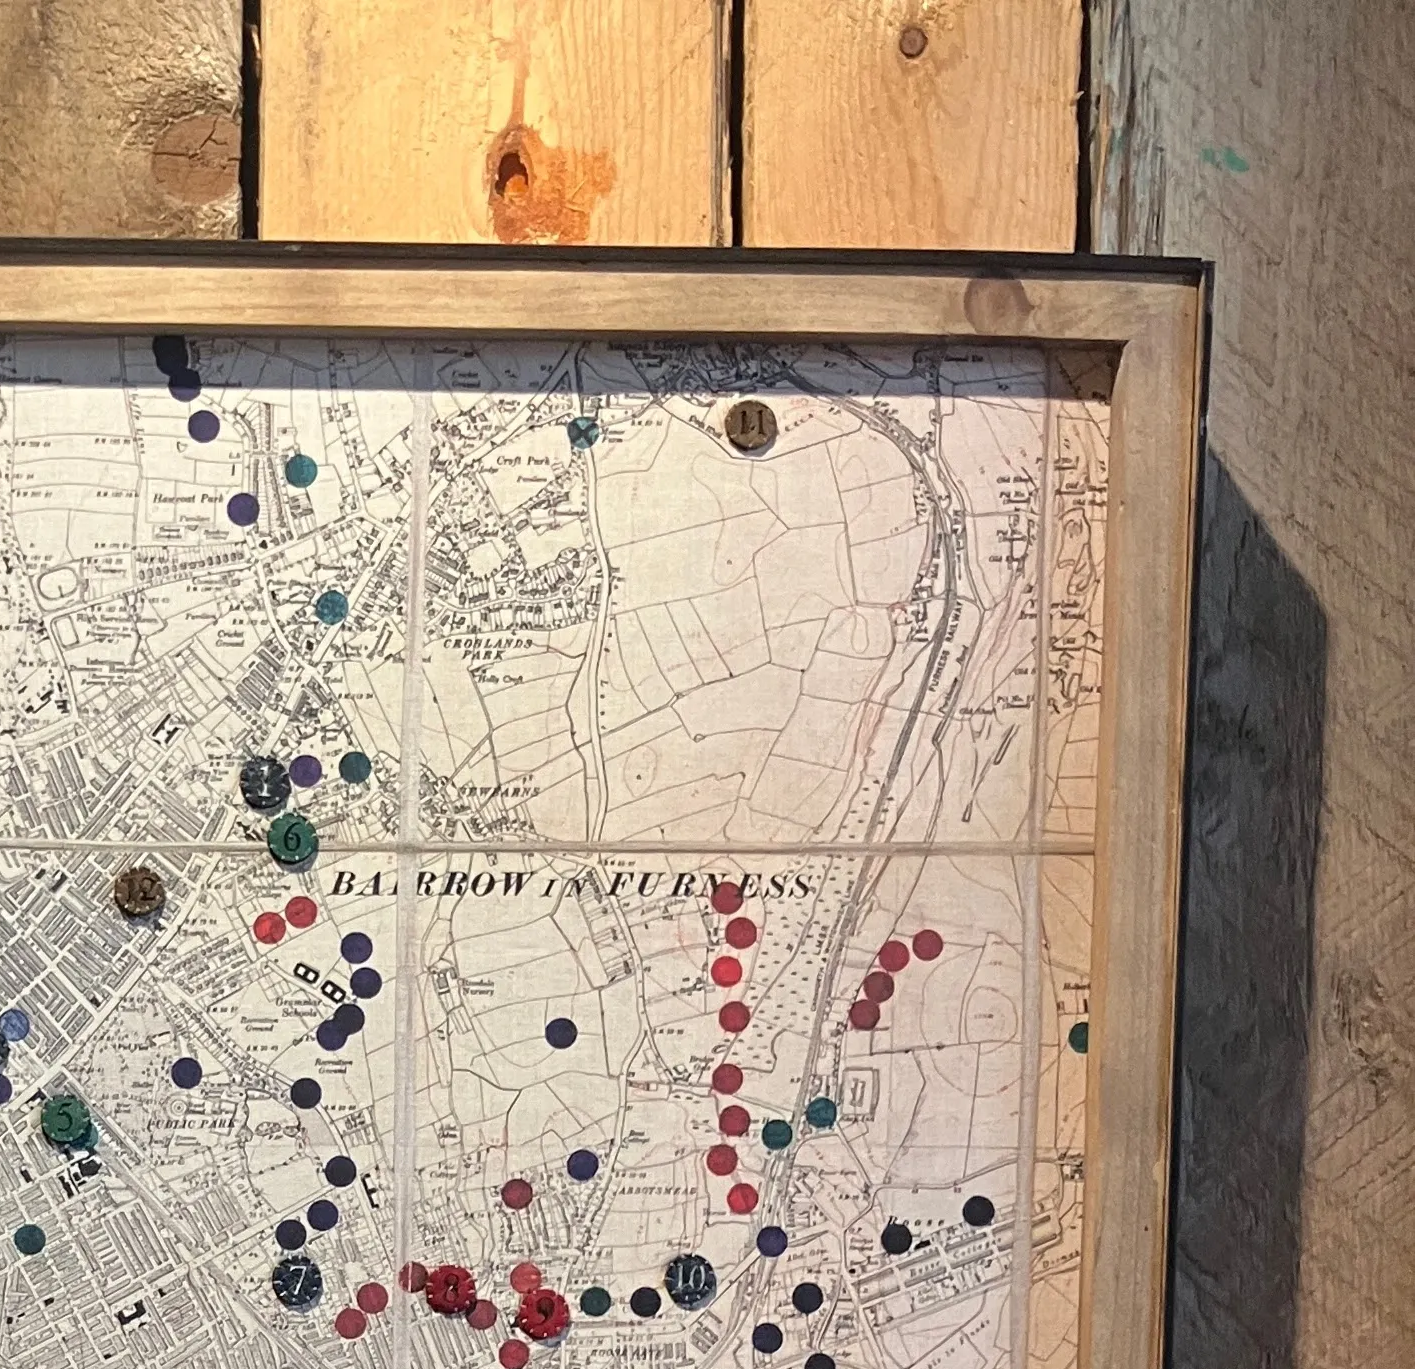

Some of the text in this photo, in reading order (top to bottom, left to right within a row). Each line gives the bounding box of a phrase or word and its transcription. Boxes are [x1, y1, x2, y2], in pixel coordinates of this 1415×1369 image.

[737, 410, 766, 436] 11
[284, 821, 302, 851] 6
[607, 870, 813, 899] FURNESS
[56, 1103, 74, 1132] 5
[288, 1265, 307, 1294] 7
[675, 1265, 706, 1292] 10
